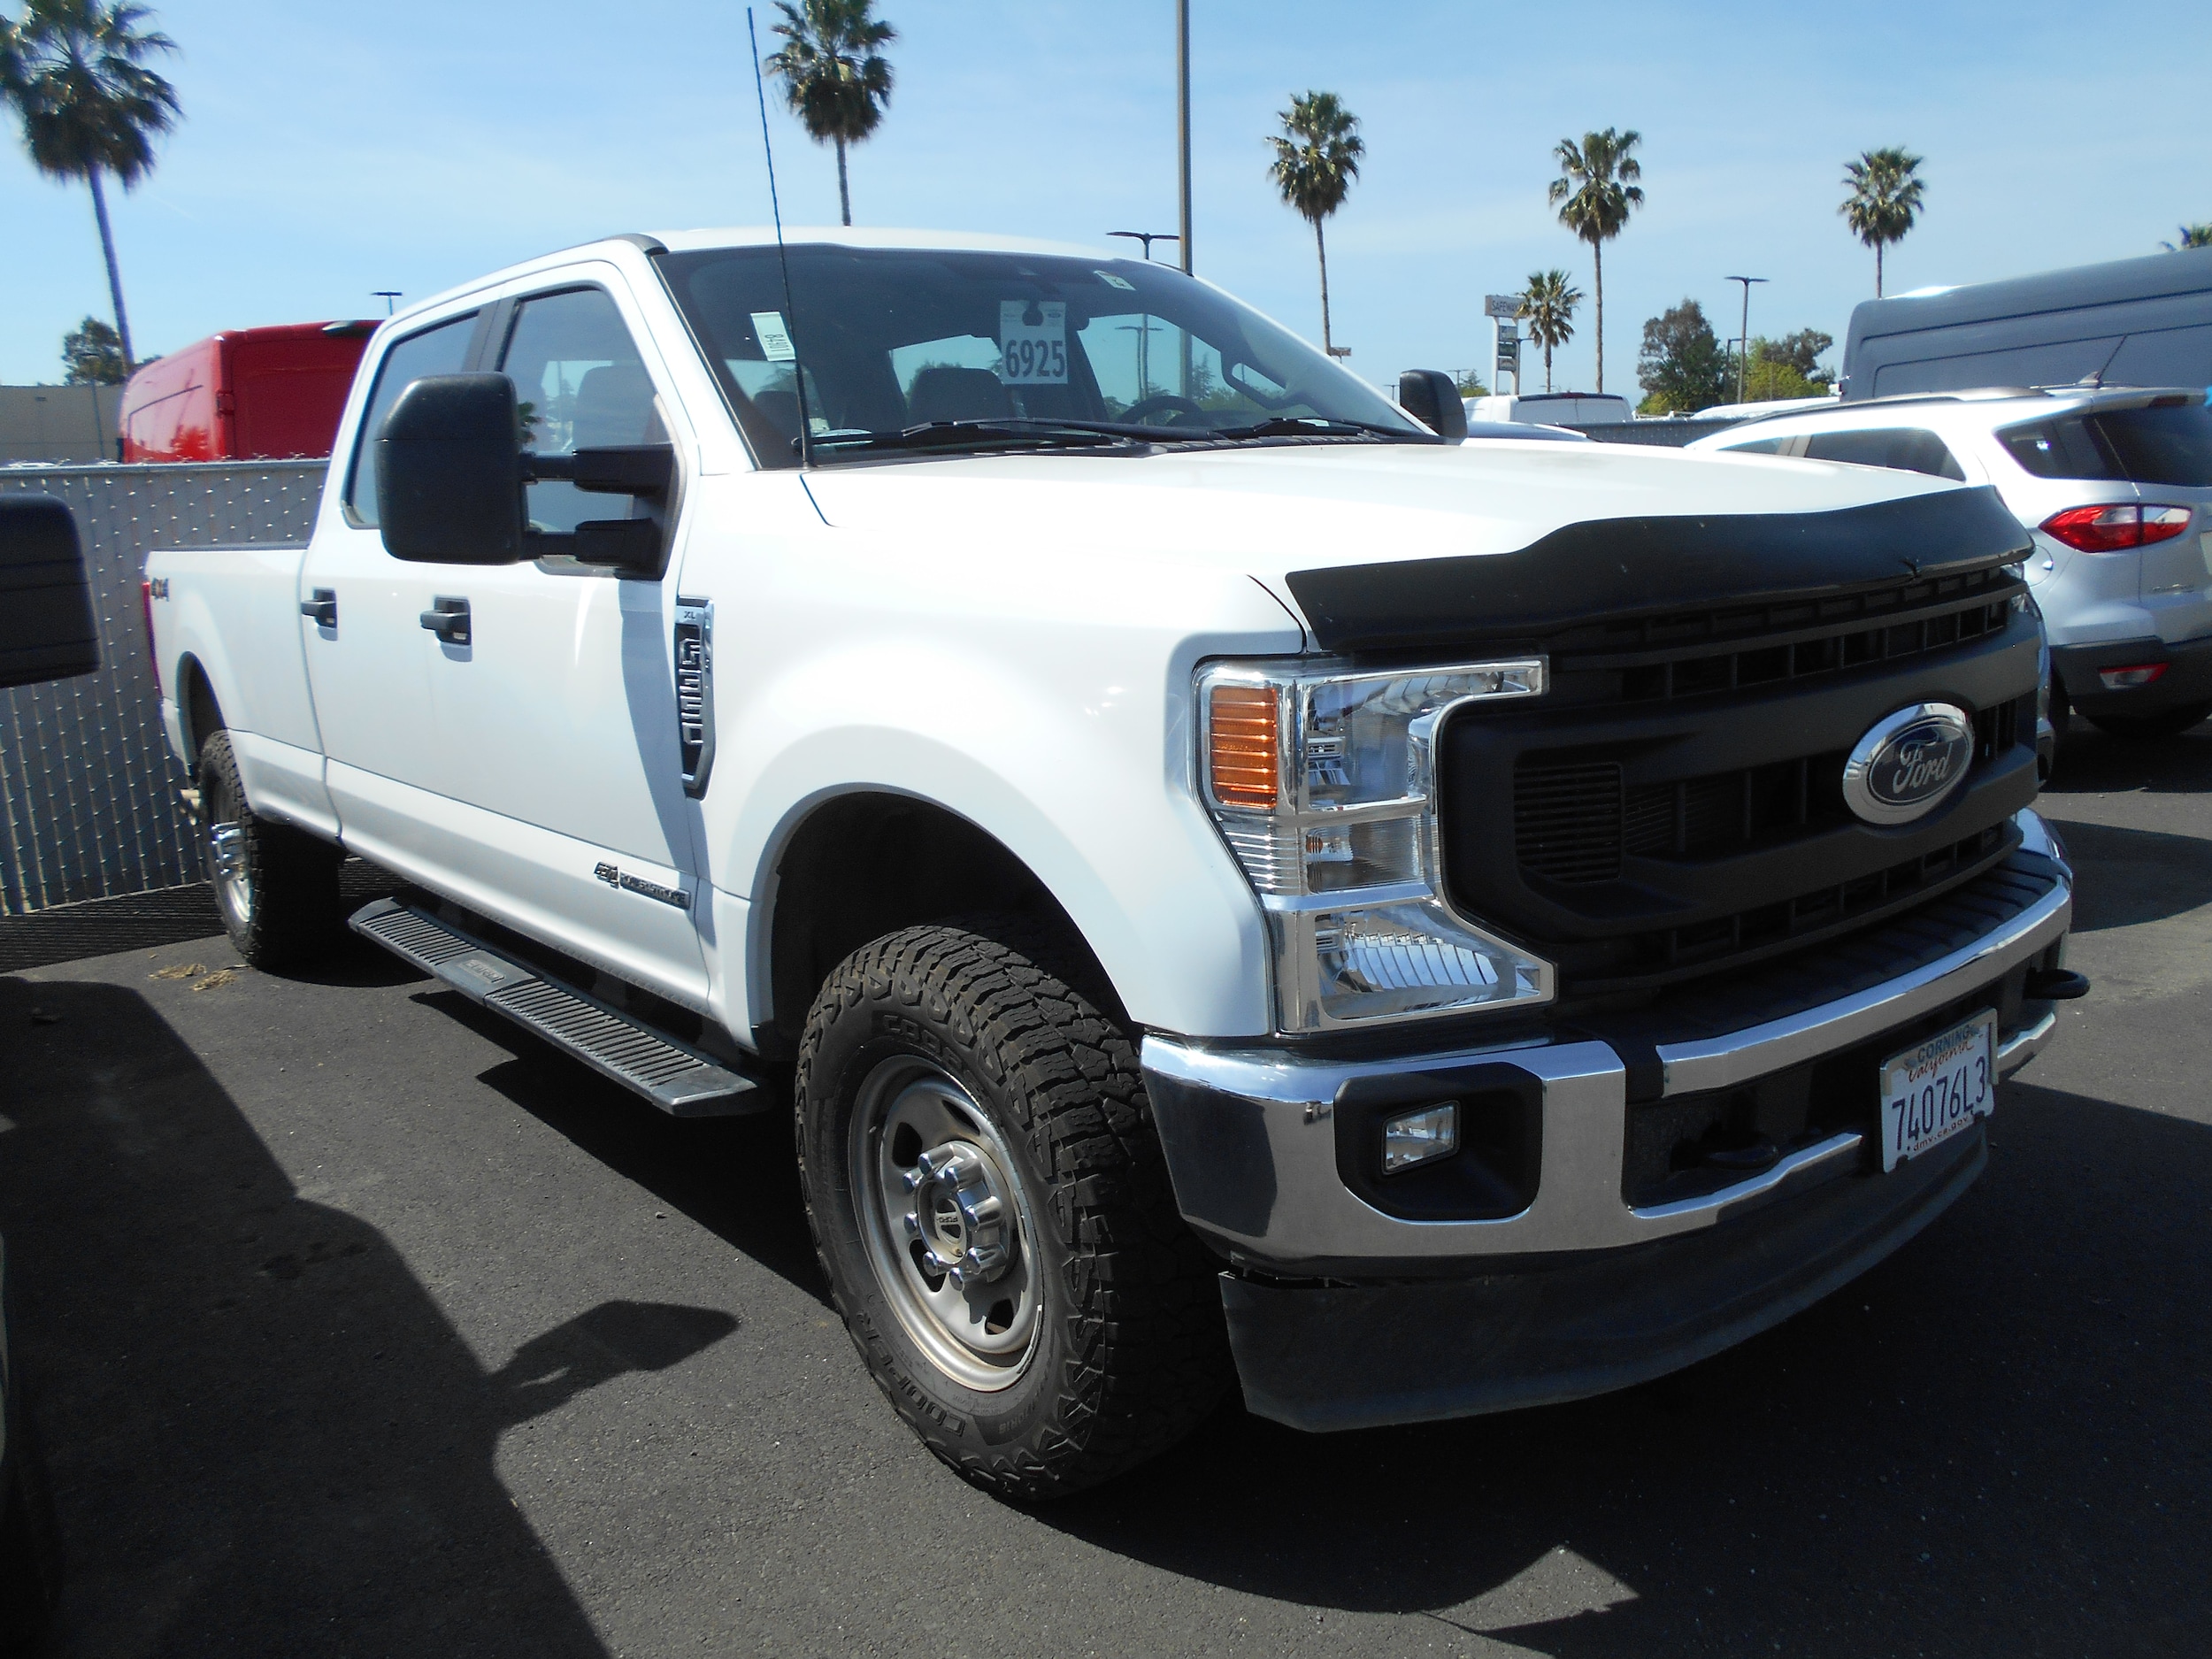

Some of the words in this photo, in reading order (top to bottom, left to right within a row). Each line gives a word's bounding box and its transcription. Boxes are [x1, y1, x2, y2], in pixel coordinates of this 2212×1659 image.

[1005, 339, 1065, 378] 6925
[683, 611, 696, 619] XL
[1892, 727, 1954, 794] Ford
[1892, 1056, 1985, 1150] 74076L3
[1913, 1115, 1969, 1151] dmv.ca.gov
